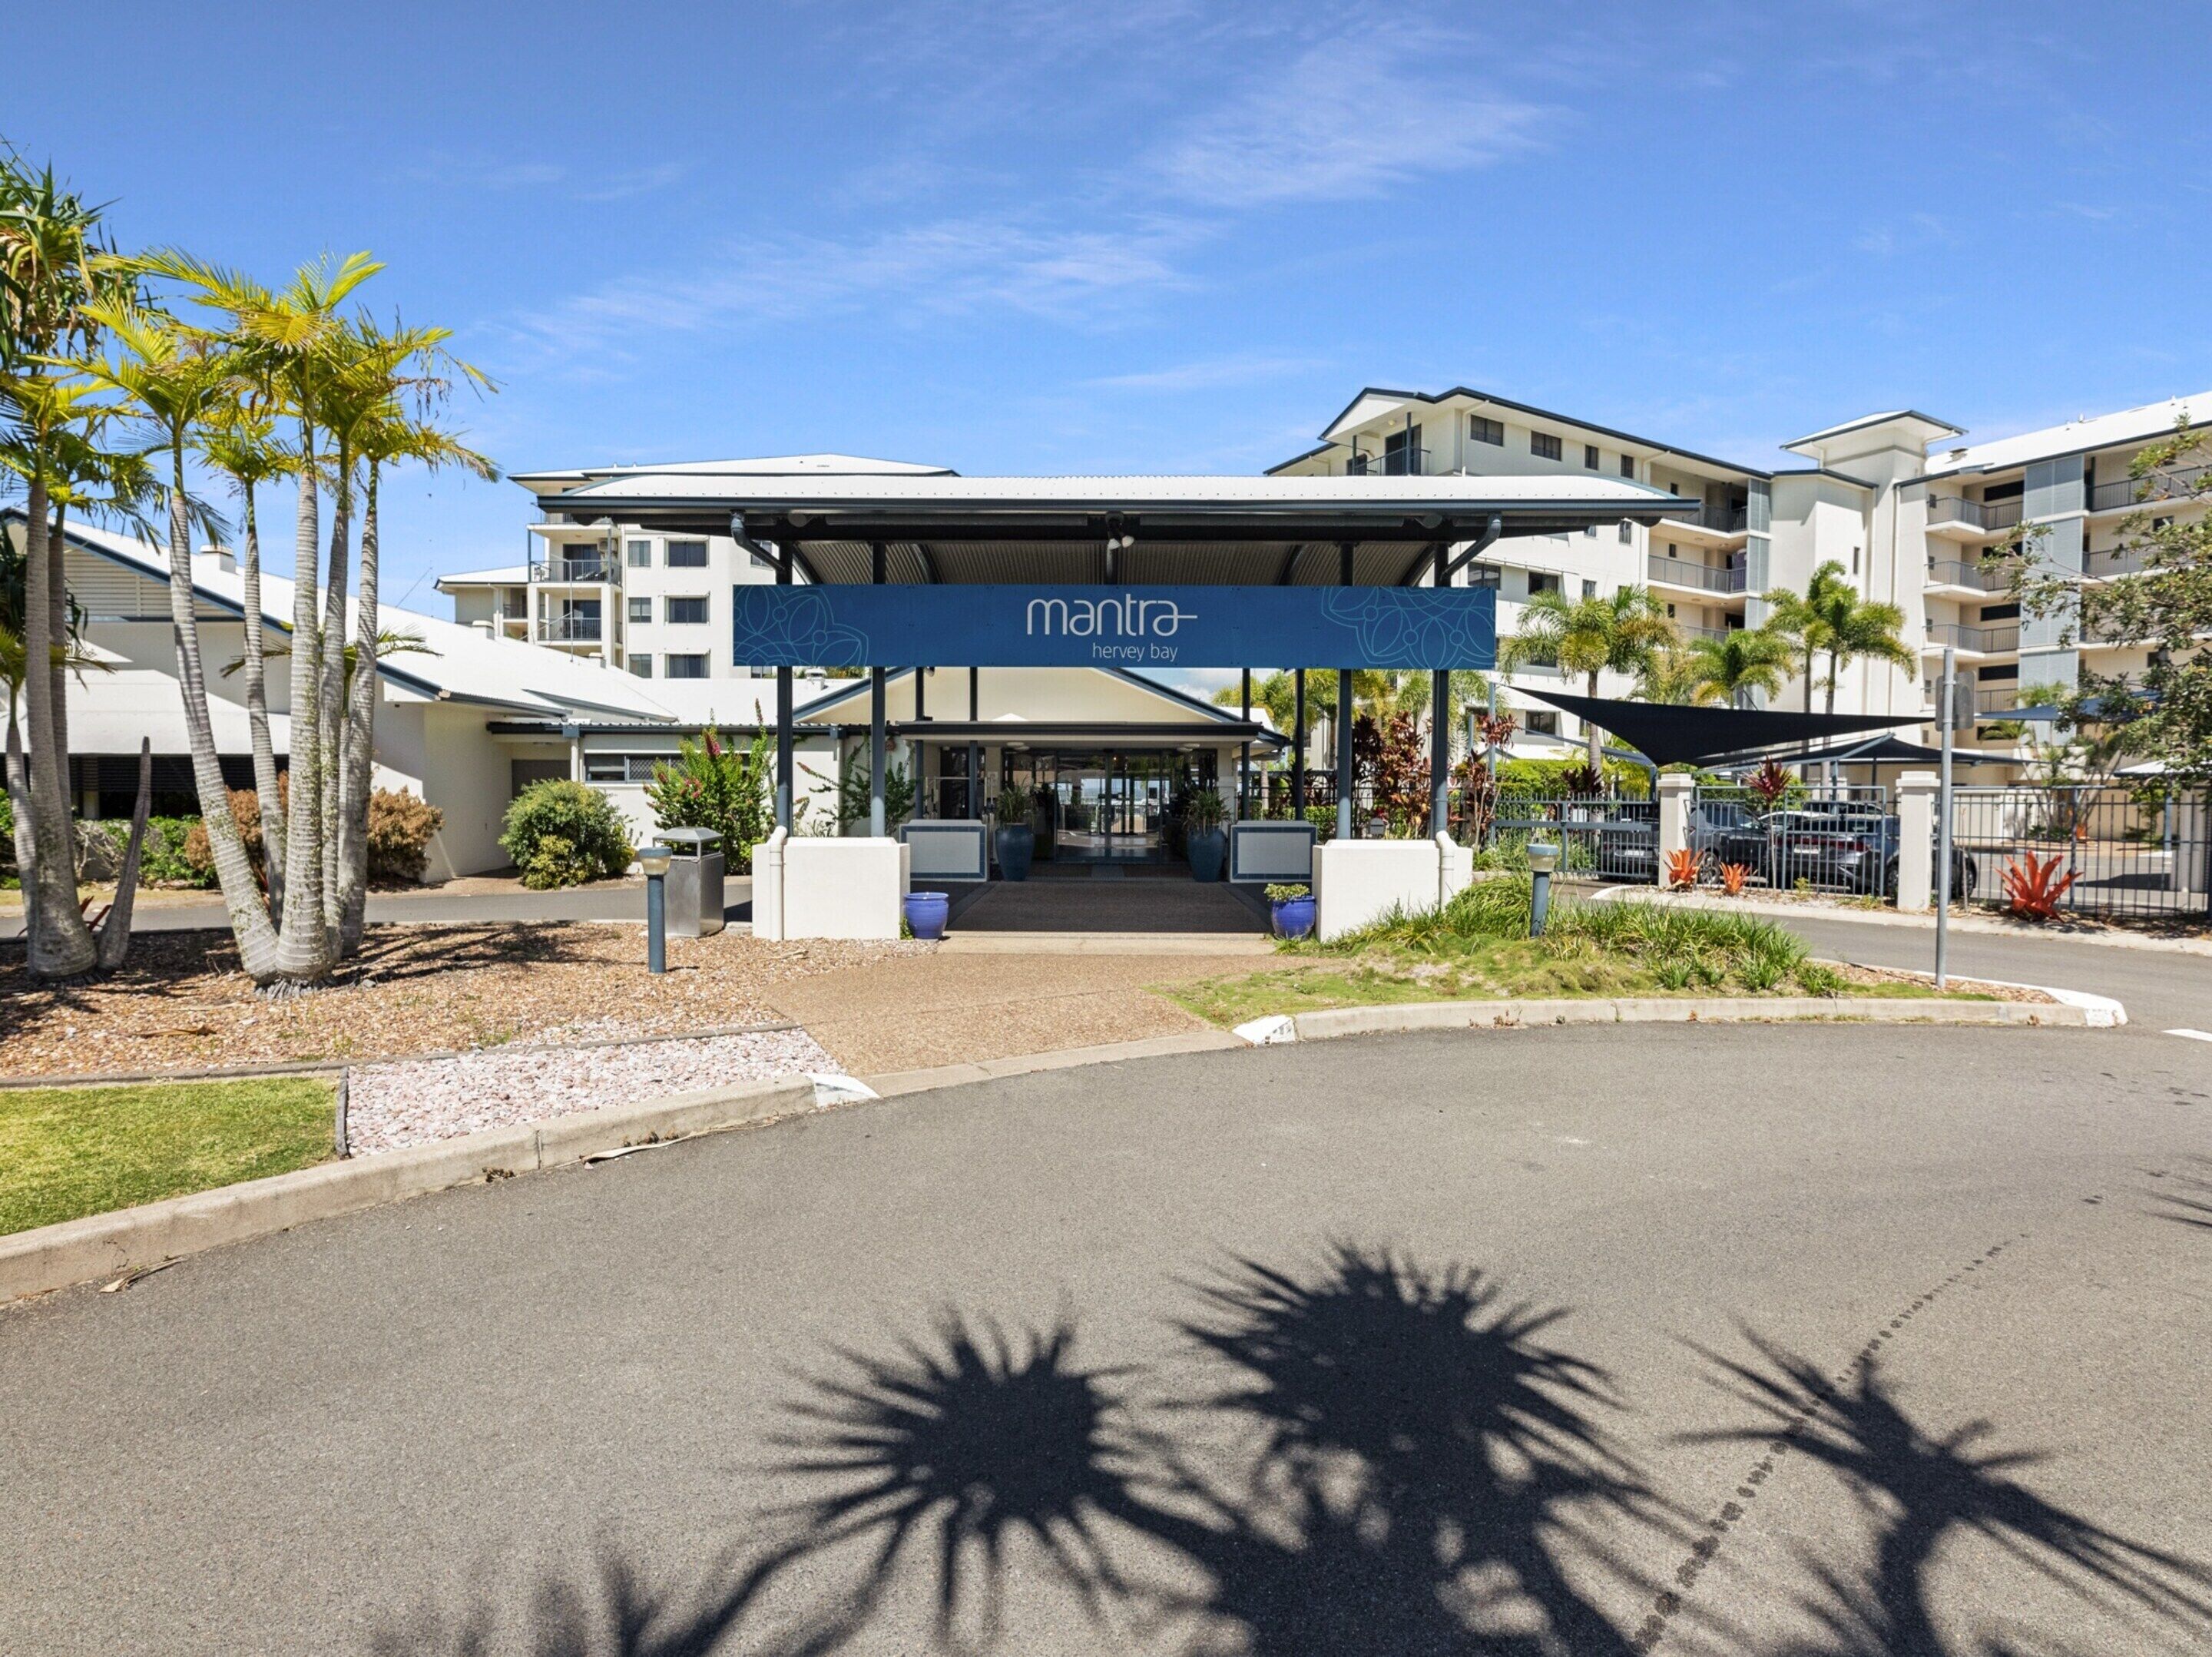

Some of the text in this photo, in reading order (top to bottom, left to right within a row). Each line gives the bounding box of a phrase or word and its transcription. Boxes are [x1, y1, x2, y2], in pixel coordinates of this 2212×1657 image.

[1026, 593, 1198, 637] mantra
[1092, 642, 1178, 662] hervey bay
